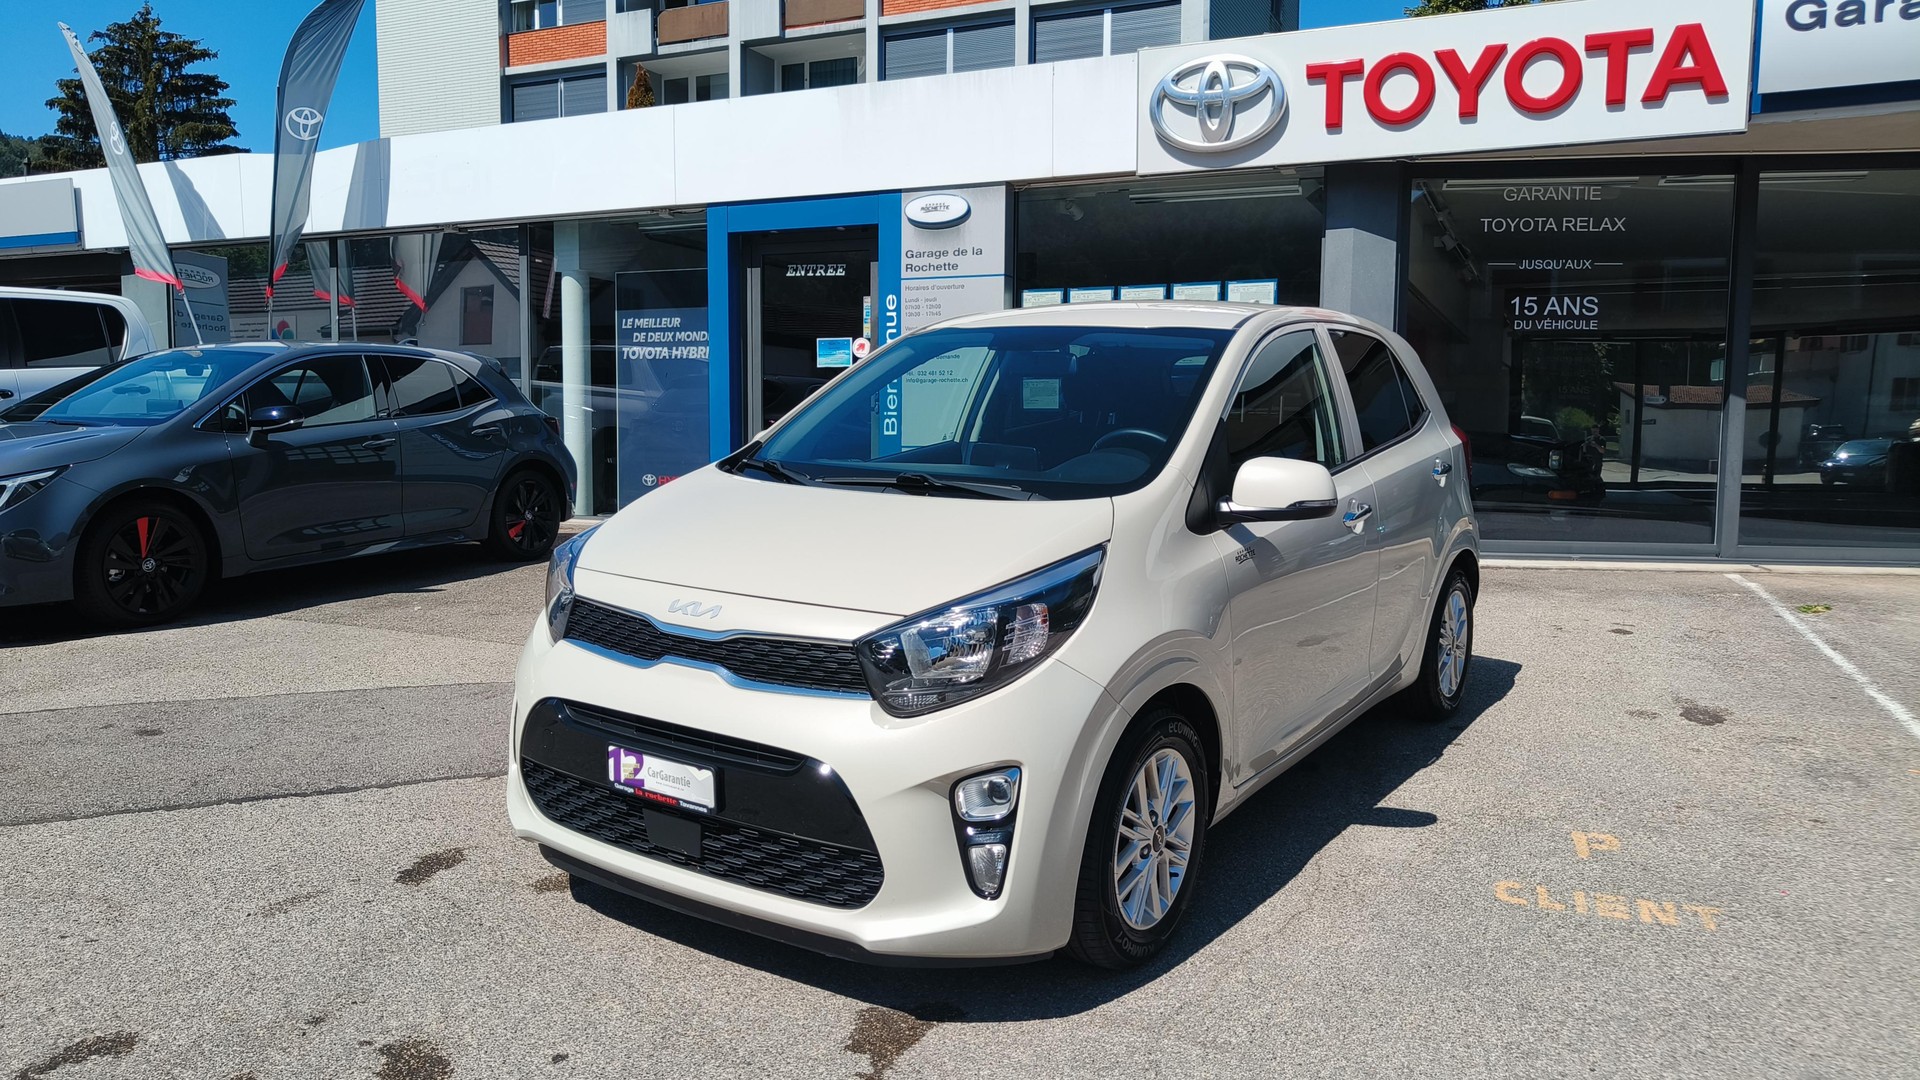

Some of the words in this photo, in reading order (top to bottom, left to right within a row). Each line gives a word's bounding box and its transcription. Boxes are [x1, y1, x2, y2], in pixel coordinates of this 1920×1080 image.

[1306, 23, 1729, 129] TOYOTA
[1503, 186, 1602, 201] GARANTIE
[1480, 218, 1558, 233] TOYOTA
[1562, 217, 1627, 232] RELAX
[905, 249, 949, 259] Garage
[952, 247, 968, 257] de
[971, 246, 984, 256] la
[785, 264, 847, 277] ENTREE
[905, 262, 959, 273] Rochette
[1518, 259, 1592, 270] JUSQU'AUX
[1511, 296, 1538, 316] 15
[1543, 296, 1599, 316] ANS
[634, 318, 681, 329] MEILLEUR
[1514, 320, 1532, 330] DU
[1535, 317, 1598, 330] VÉHICULE
[633, 333, 646, 343] DE
[648, 332, 675, 342] DEUX
[675, 331, 710, 342] MOND
[622, 347, 669, 360] TOYOTA
[883, 293, 899, 436] Biennue
[668, 598, 723, 619] KIA
[608, 745, 645, 787] 12
[647, 766, 691, 788] CarGarantie
[1571, 831, 1621, 860] P
[1494, 881, 1721, 932] CLIENT
